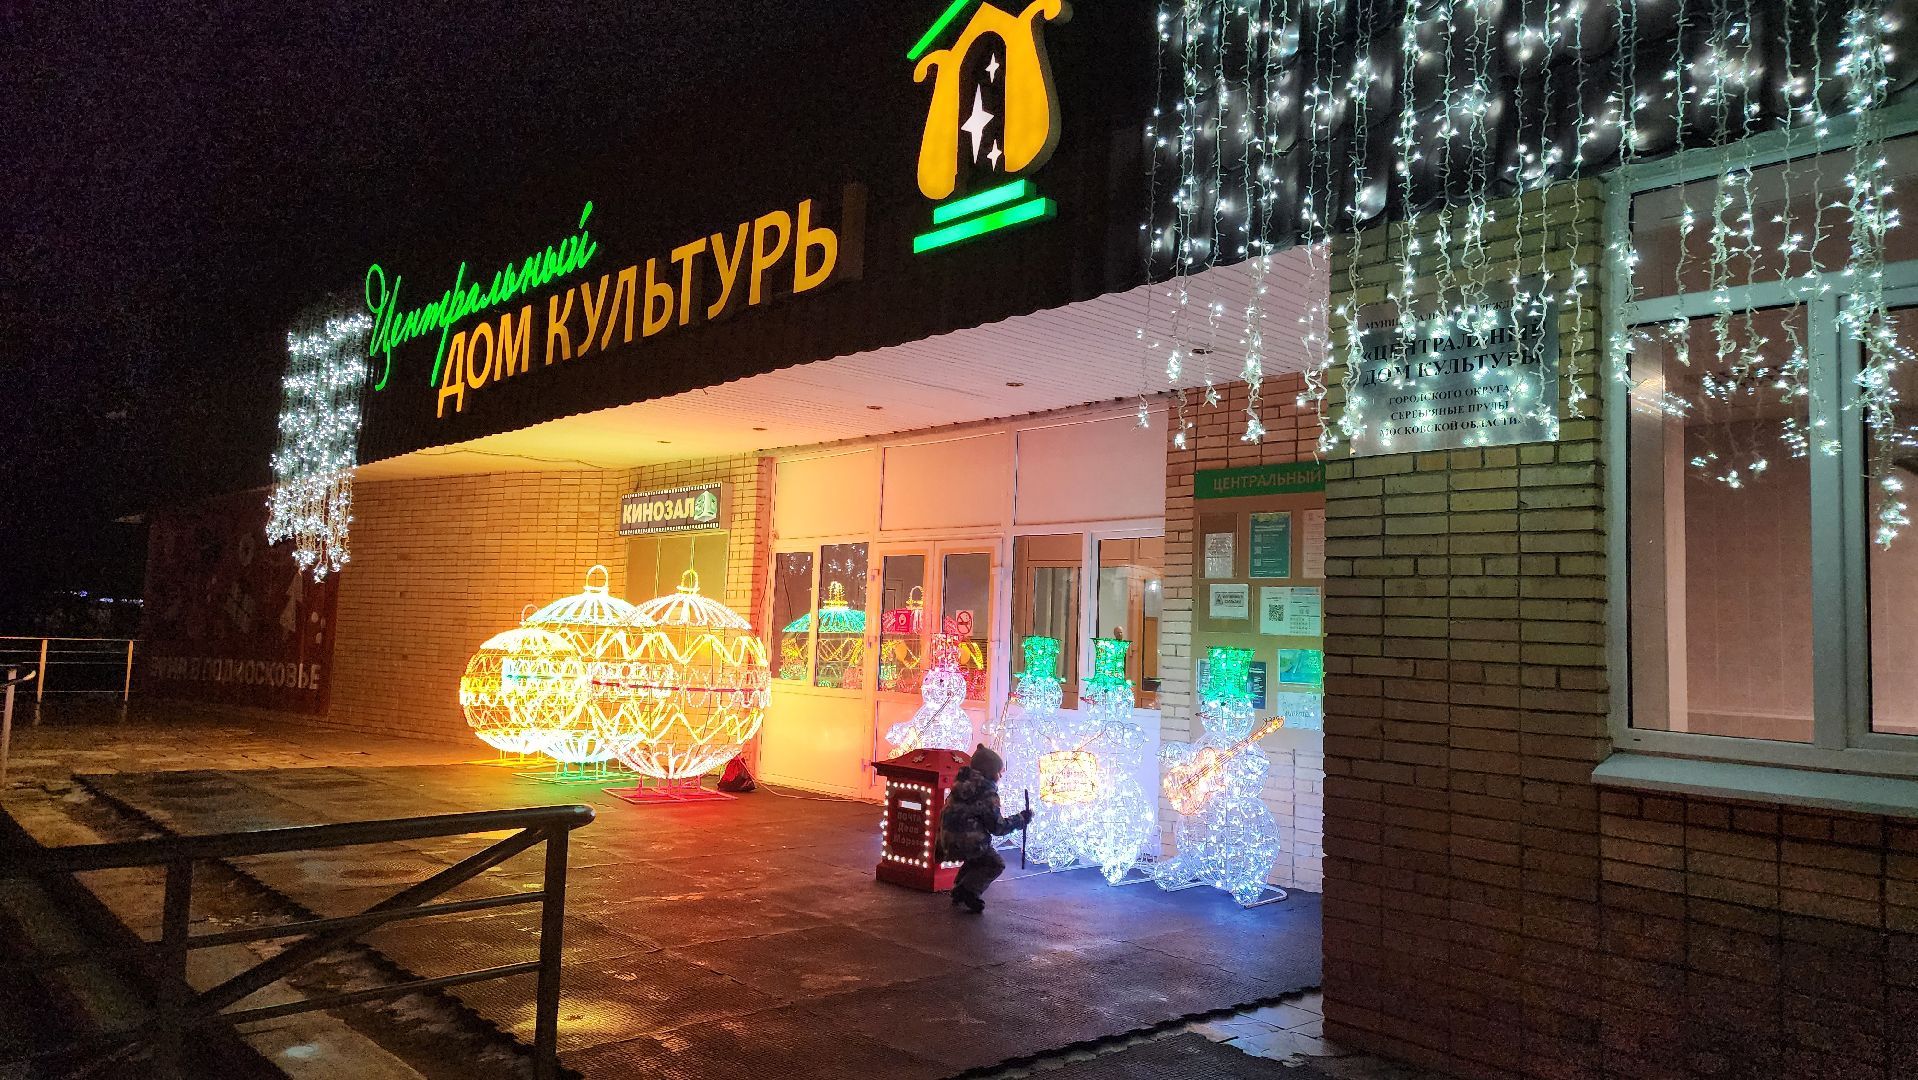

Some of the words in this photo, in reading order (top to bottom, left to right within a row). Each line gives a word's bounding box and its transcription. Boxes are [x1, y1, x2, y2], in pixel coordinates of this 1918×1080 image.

[366, 201, 597, 391] Центральный
[437, 305, 532, 418] ДОМ
[1363, 365, 1410, 389] ДОМ
[1390, 390, 1461, 405] ГОРОДСКОГО
[1465, 385, 1509, 398] ОКРУГА
[1213, 467, 1321, 493] ЦЕНТРАЛЬНЫЙ
[622, 497, 695, 524] КИНОЗАЛ
